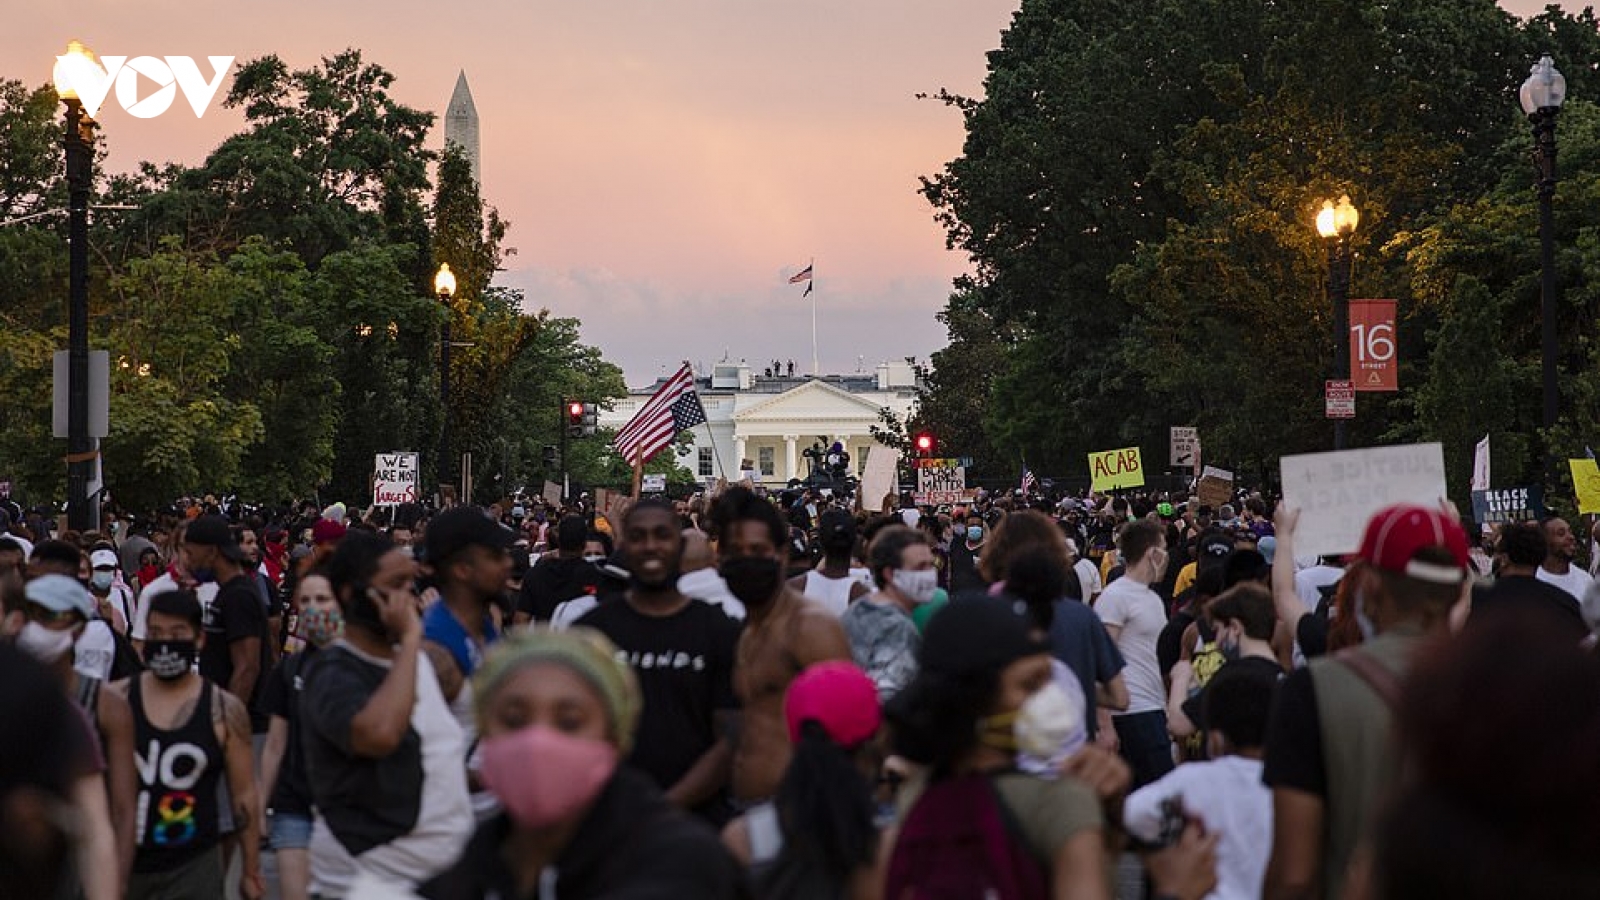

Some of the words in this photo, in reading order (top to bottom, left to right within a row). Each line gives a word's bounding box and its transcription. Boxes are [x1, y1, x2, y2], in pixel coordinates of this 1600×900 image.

[1173, 430, 1194, 438] STOP
[382, 456, 410, 468] WE
[1095, 450, 1139, 478] ACAB
[375, 470, 397, 483] ARE
[399, 470, 417, 483] NOT
[922, 466, 957, 478] BLACK
[922, 479, 963, 492] MATTER
[1485, 488, 1528, 502] BLACK
[1489, 499, 1526, 512] LIVES
[1483, 510, 1534, 522] MATTER
[133, 739, 208, 791] NO
